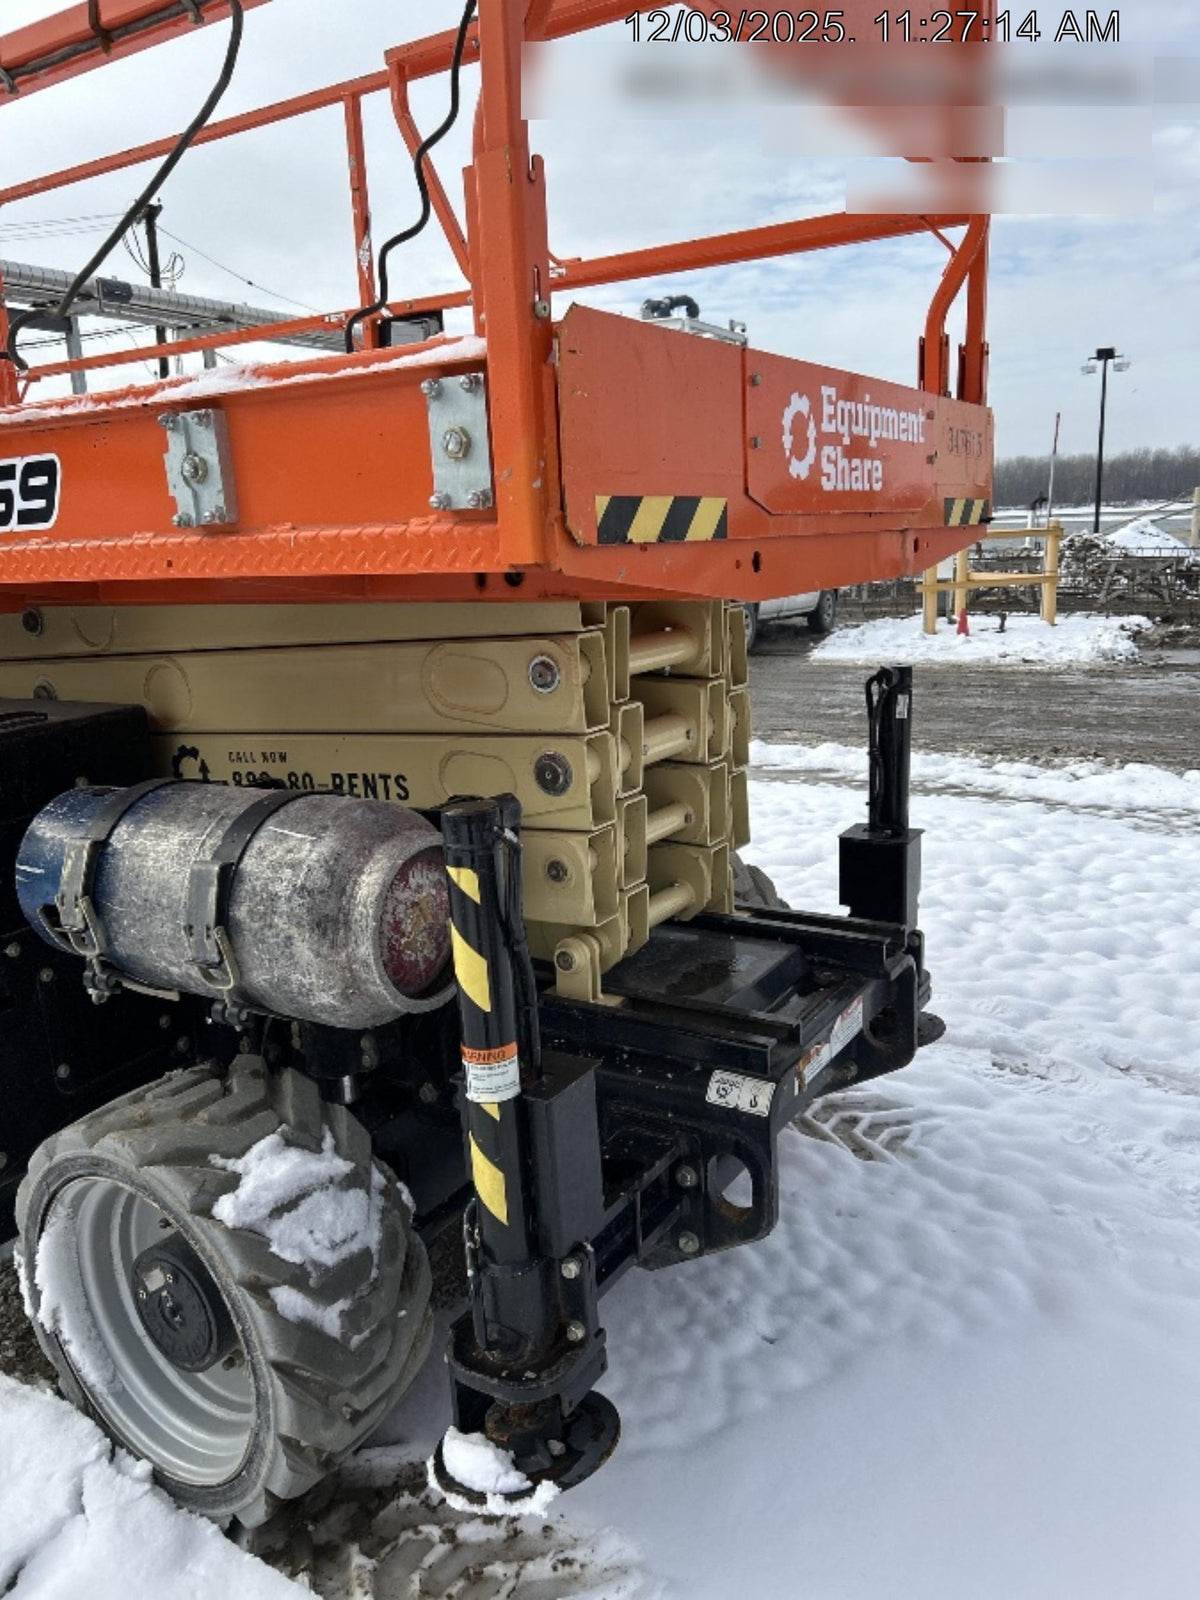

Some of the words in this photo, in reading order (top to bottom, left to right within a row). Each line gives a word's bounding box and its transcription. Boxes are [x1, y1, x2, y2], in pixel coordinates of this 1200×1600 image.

[821, 385, 925, 448] Equipment
[821, 446, 883, 491] Share
[228, 751, 257, 764] CALL
[260, 751, 287, 764] NOW
